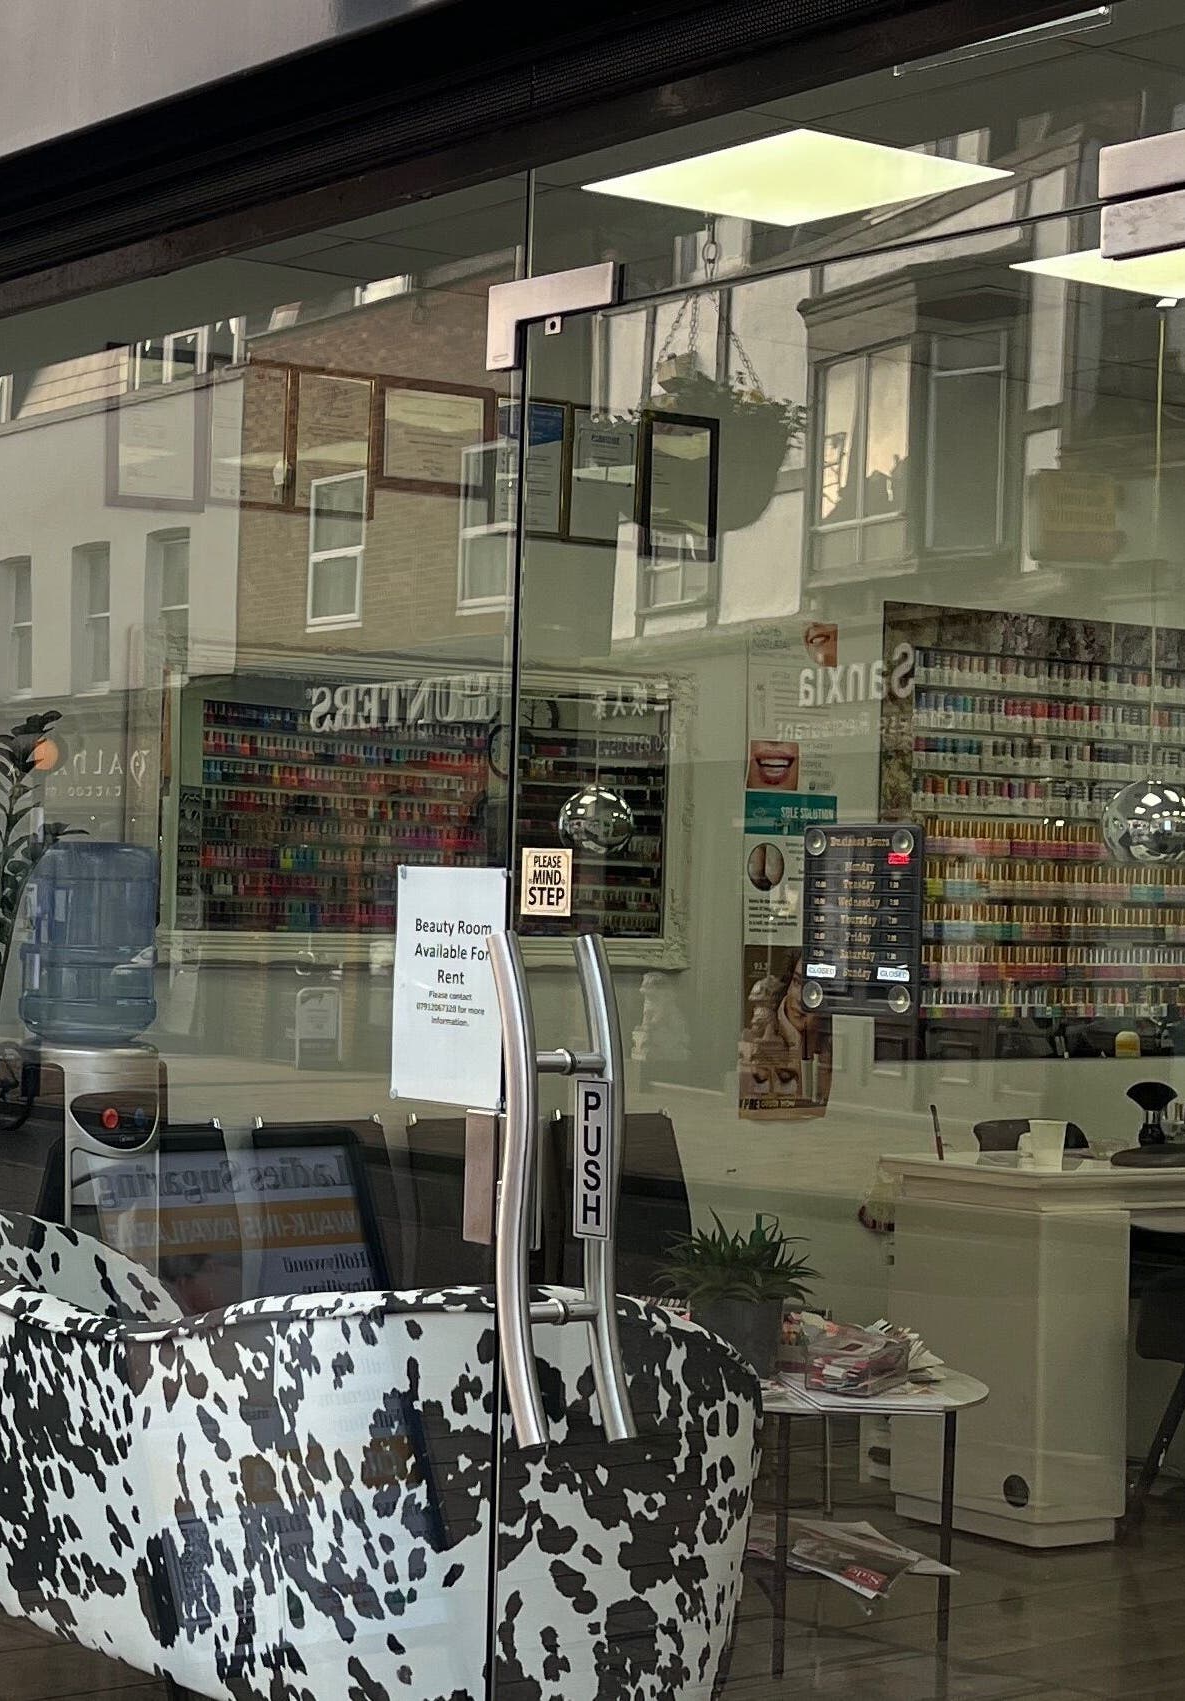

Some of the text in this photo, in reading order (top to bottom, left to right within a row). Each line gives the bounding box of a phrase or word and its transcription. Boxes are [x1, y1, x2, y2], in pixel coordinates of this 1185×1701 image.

[533, 855, 562, 869] PLEASE
[532, 869, 562, 886] MIND
[527, 887, 565, 906] STEP
[838, 897, 880, 910] Wednesday
[415, 918, 492, 937] Beauty Room
[840, 915, 877, 929] Thursday
[845, 932, 872, 945] Friday
[415, 942, 490, 961] Available For
[838, 949, 876, 963] Saturday
[437, 969, 465, 985] Rent
[428, 990, 472, 1001] Please contact
[458, 1005, 467, 1014] for
[468, 1008, 485, 1016] more
[582, 1090, 602, 1227] PUSH
